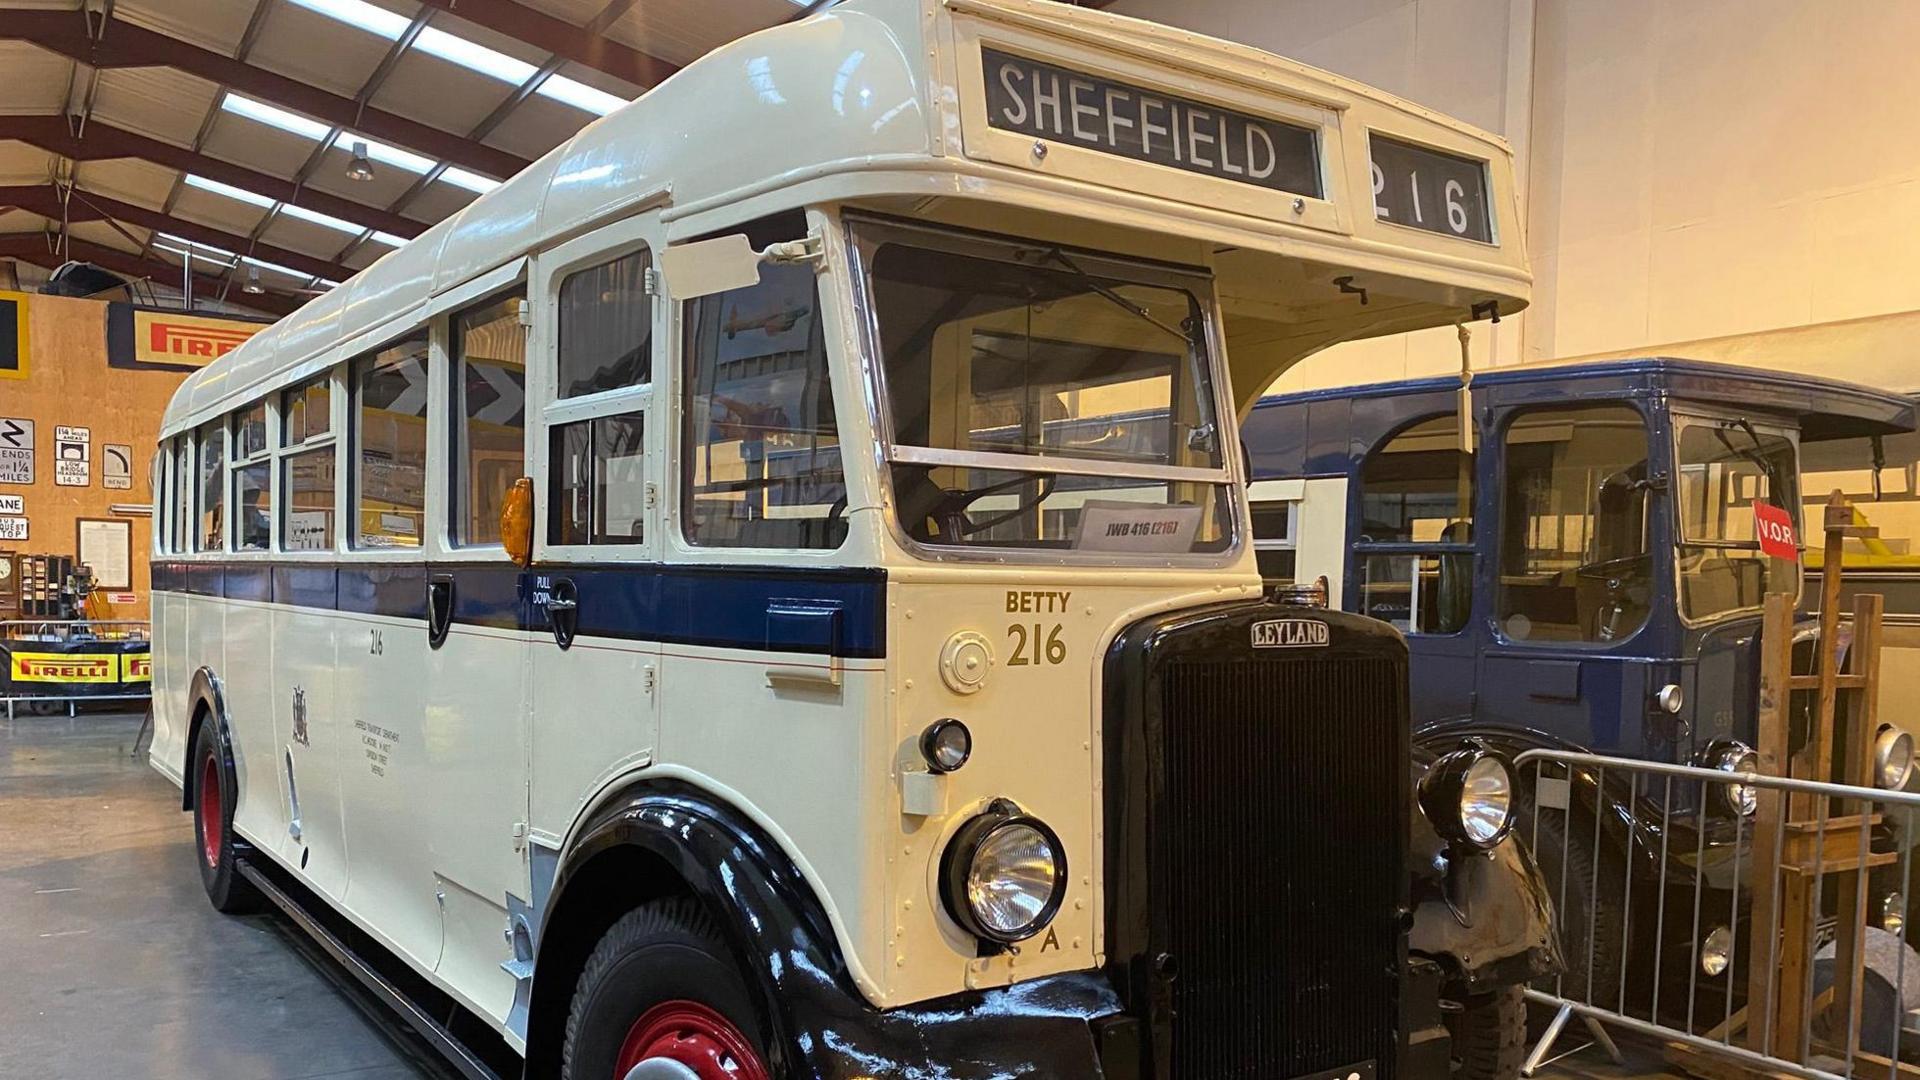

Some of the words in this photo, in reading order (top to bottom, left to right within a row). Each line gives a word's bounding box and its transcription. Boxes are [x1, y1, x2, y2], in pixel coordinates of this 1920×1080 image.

[1000, 63, 1276, 179] SHEFFIELD
[0, 450, 31, 459] ENDS
[0, 499, 21, 510] ANE
[0, 524, 24, 532] QUEST
[1105, 523, 1130, 537] JWB
[1131, 522, 1151, 536] 416
[536, 576, 551, 589] PULL
[1006, 591, 1071, 613] BETTY
[370, 629, 383, 656] 216
[1254, 622, 1328, 645] LEYLAND
[1007, 623, 1066, 666] 216
[20, 659, 110, 677] PIRELLI
[1040, 924, 1060, 953] A
